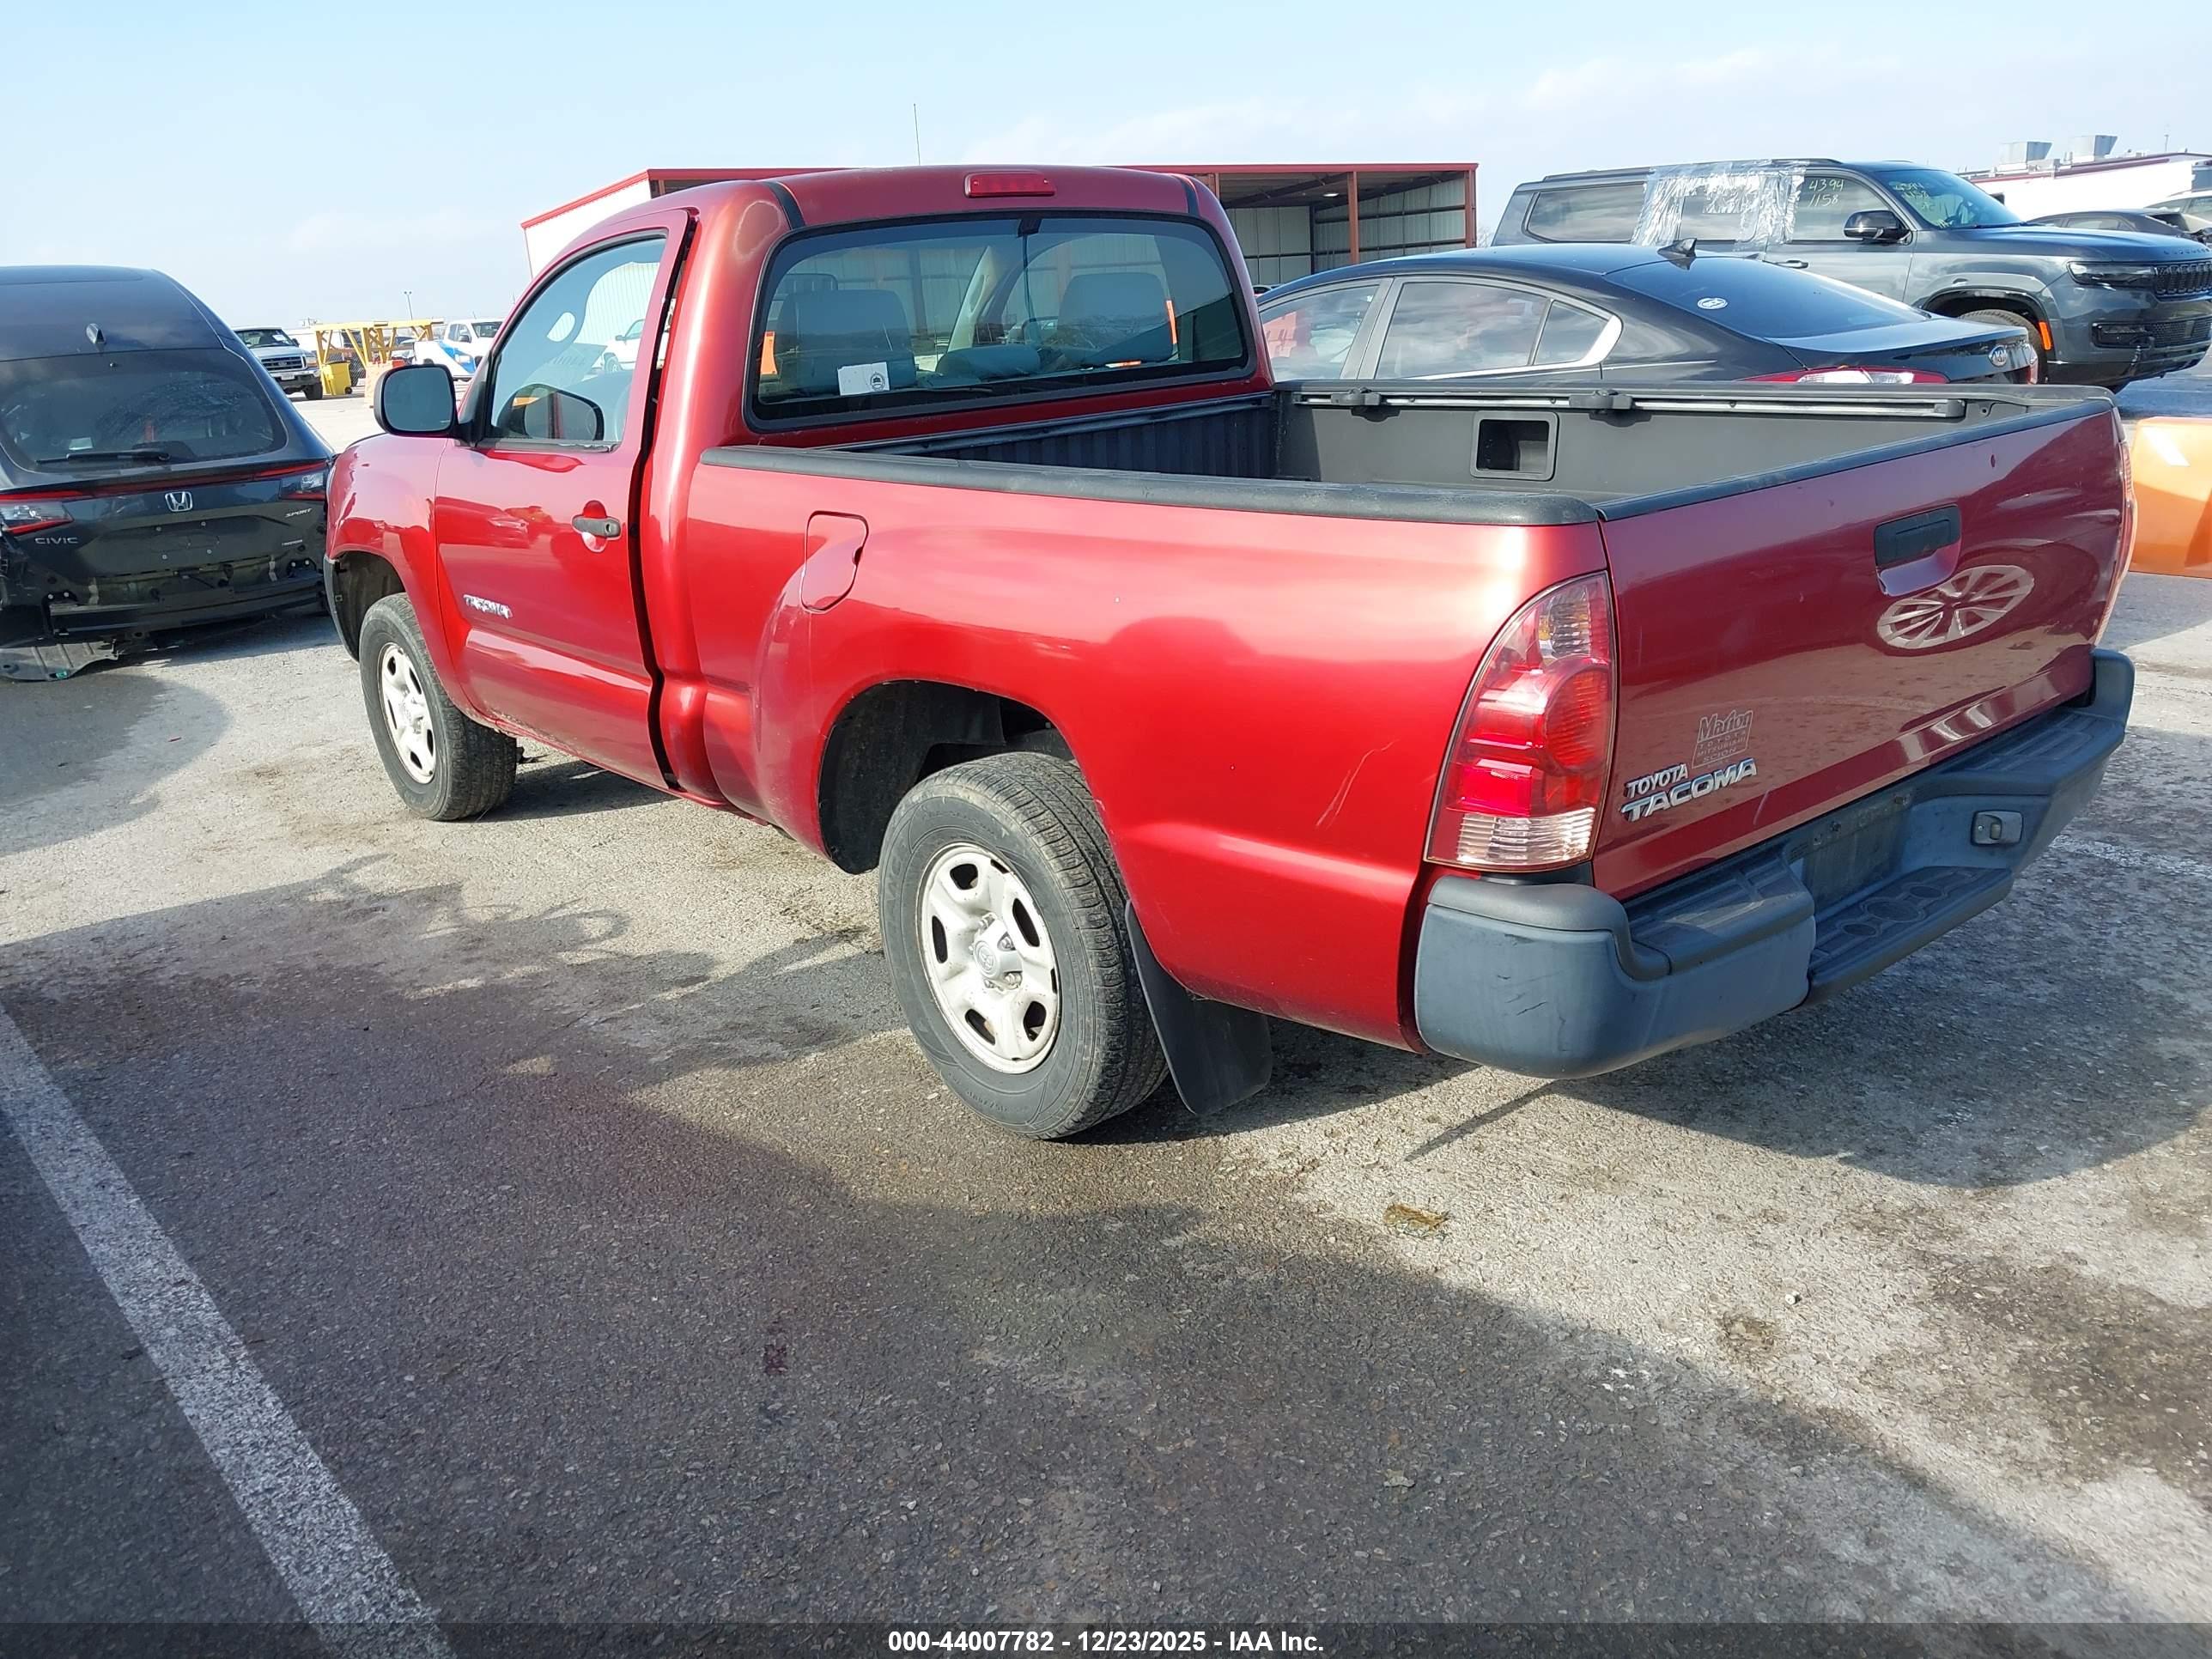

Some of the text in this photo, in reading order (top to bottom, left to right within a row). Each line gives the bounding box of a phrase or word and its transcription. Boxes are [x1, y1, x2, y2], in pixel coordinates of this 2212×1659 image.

[1808, 179, 1844, 192] 4394
[1808, 193, 1839, 208] 1158
[1703, 746, 1737, 763] SCION
[1625, 763, 1689, 799] TOYOTA
[1620, 757, 1758, 823] TACOMA
